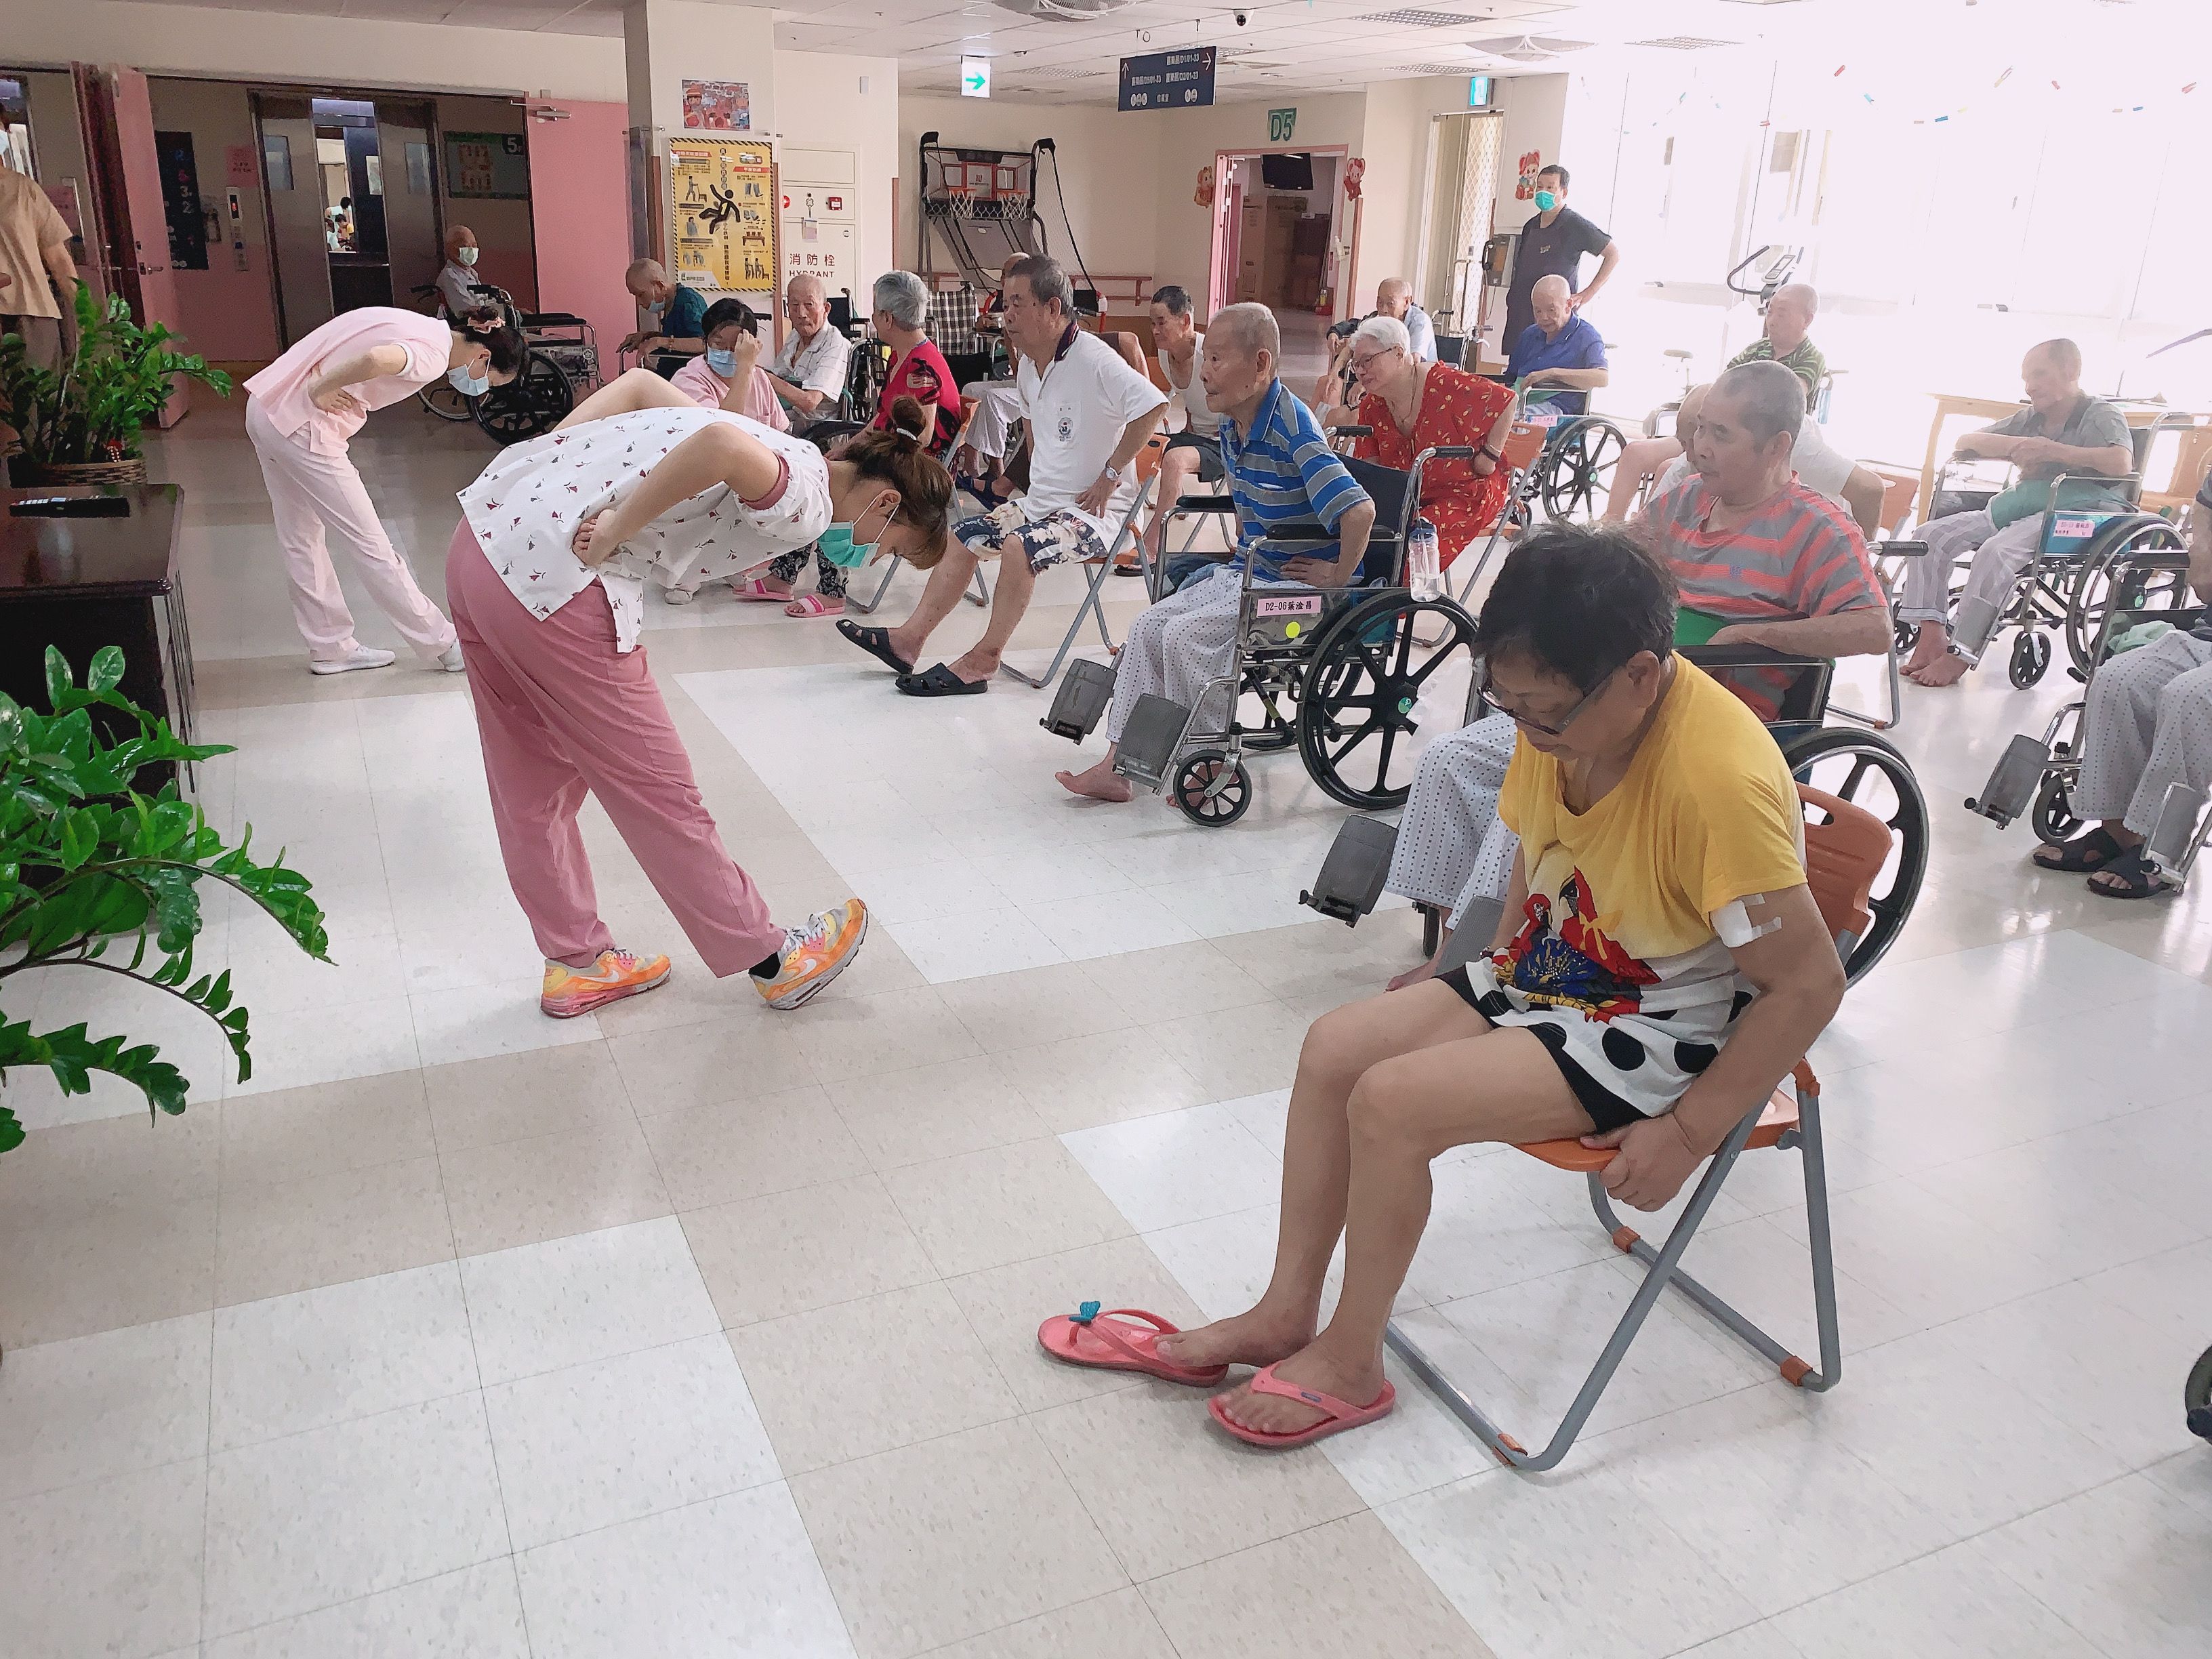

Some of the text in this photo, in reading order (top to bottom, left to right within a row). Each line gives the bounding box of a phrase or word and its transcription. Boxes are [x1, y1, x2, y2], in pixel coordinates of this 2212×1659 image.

[1270, 113, 1292, 141] D5
[790, 253, 836, 266] 消防栓
